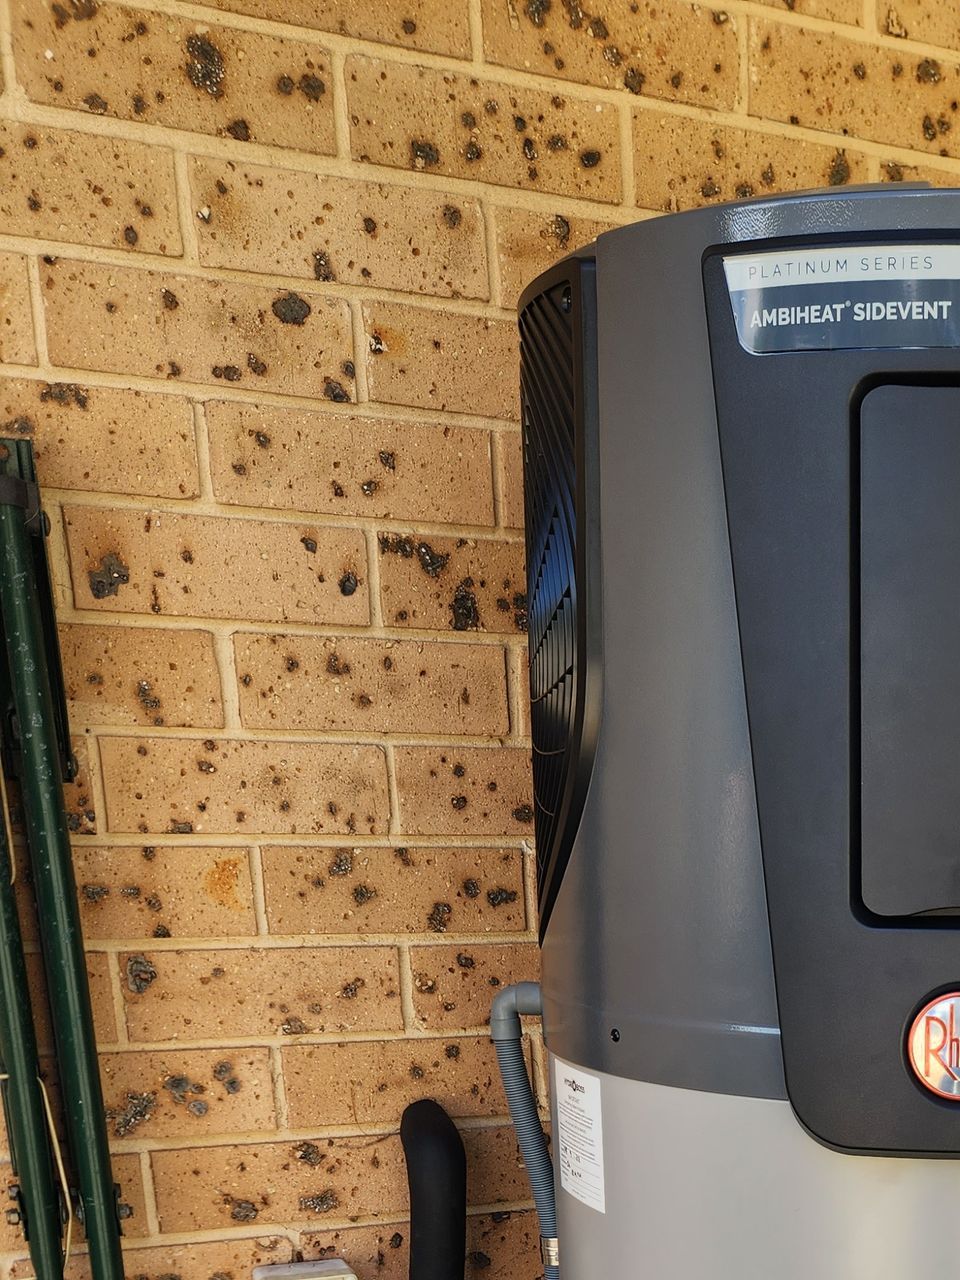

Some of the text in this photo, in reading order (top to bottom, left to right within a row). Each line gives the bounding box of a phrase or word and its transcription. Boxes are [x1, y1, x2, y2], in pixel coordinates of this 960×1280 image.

[748, 255, 933, 280] PLATINUM SERIES
[853, 301, 952, 321] SIDEVENT
